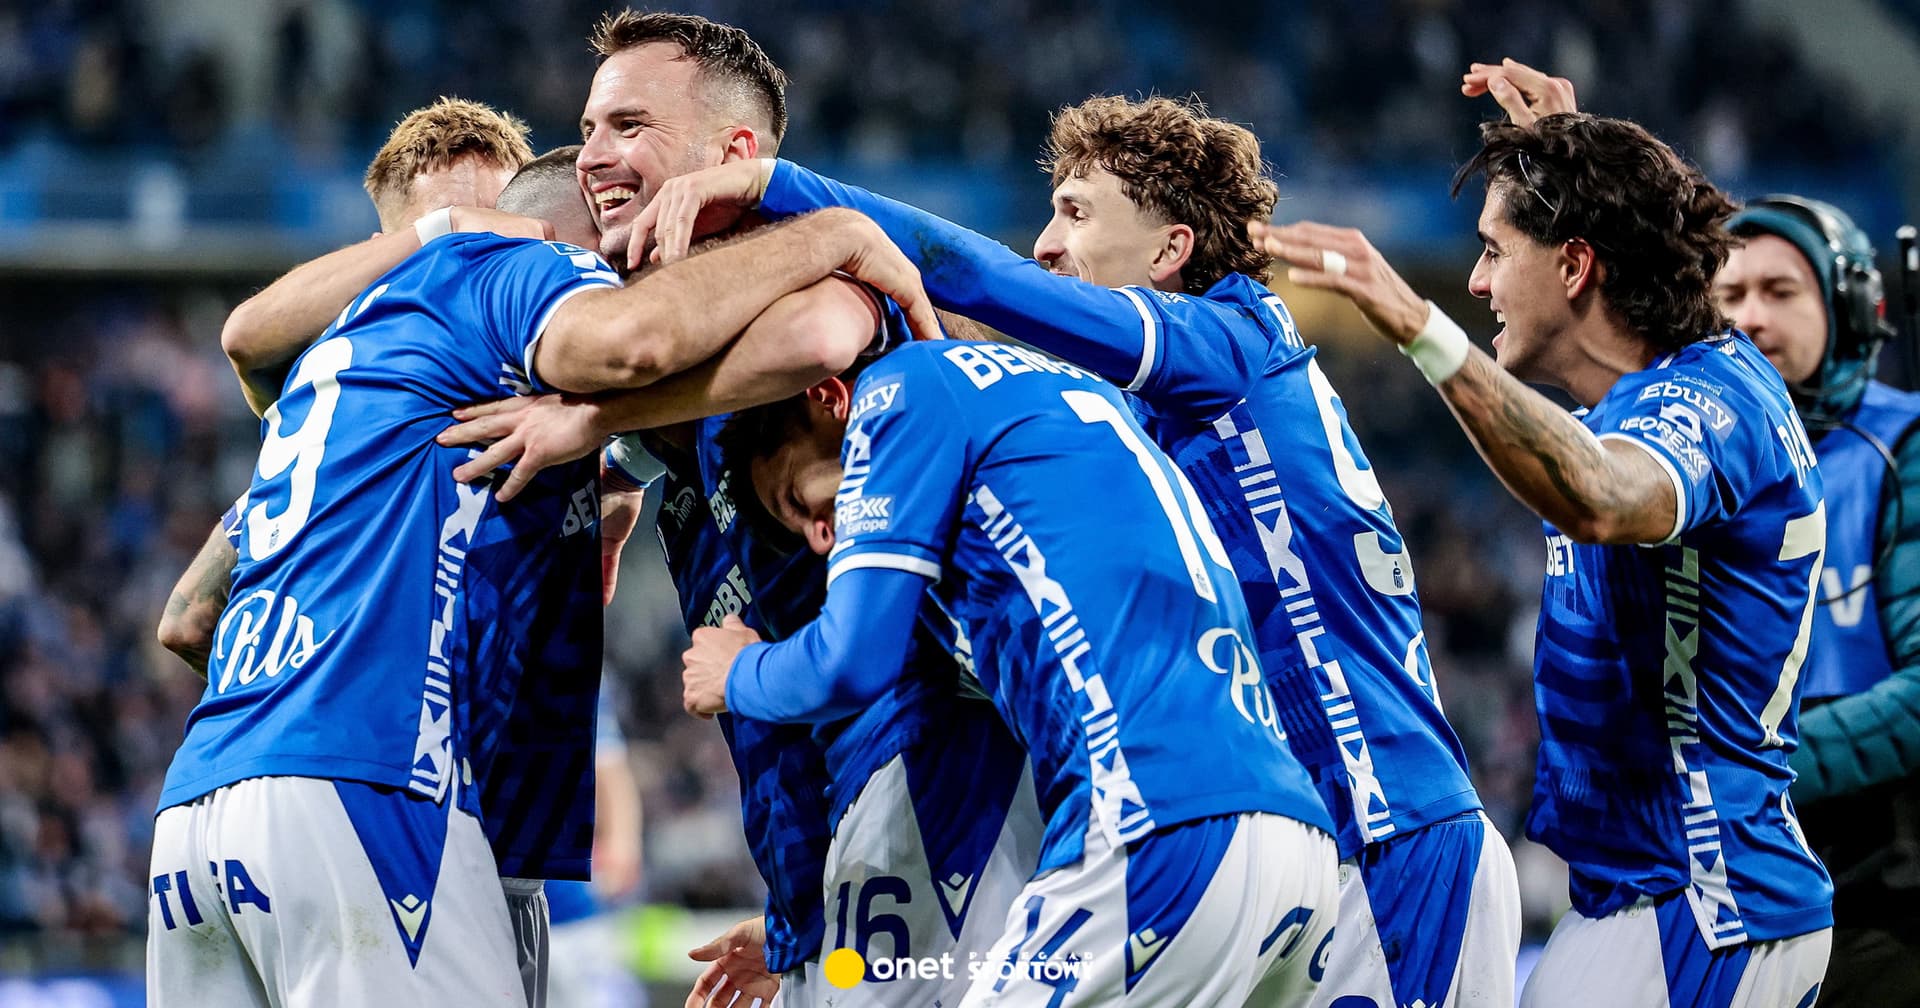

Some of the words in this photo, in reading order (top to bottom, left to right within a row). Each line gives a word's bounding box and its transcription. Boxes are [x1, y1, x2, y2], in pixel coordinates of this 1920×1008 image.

[847, 382, 900, 430] ury
[1639, 382, 1732, 430] Ebury
[252, 337, 352, 562] 9
[836, 497, 892, 529] REX
[846, 518, 889, 536] Europe
[216, 589, 337, 694] Pils
[1757, 498, 1826, 748] 7
[834, 876, 912, 983] 16
